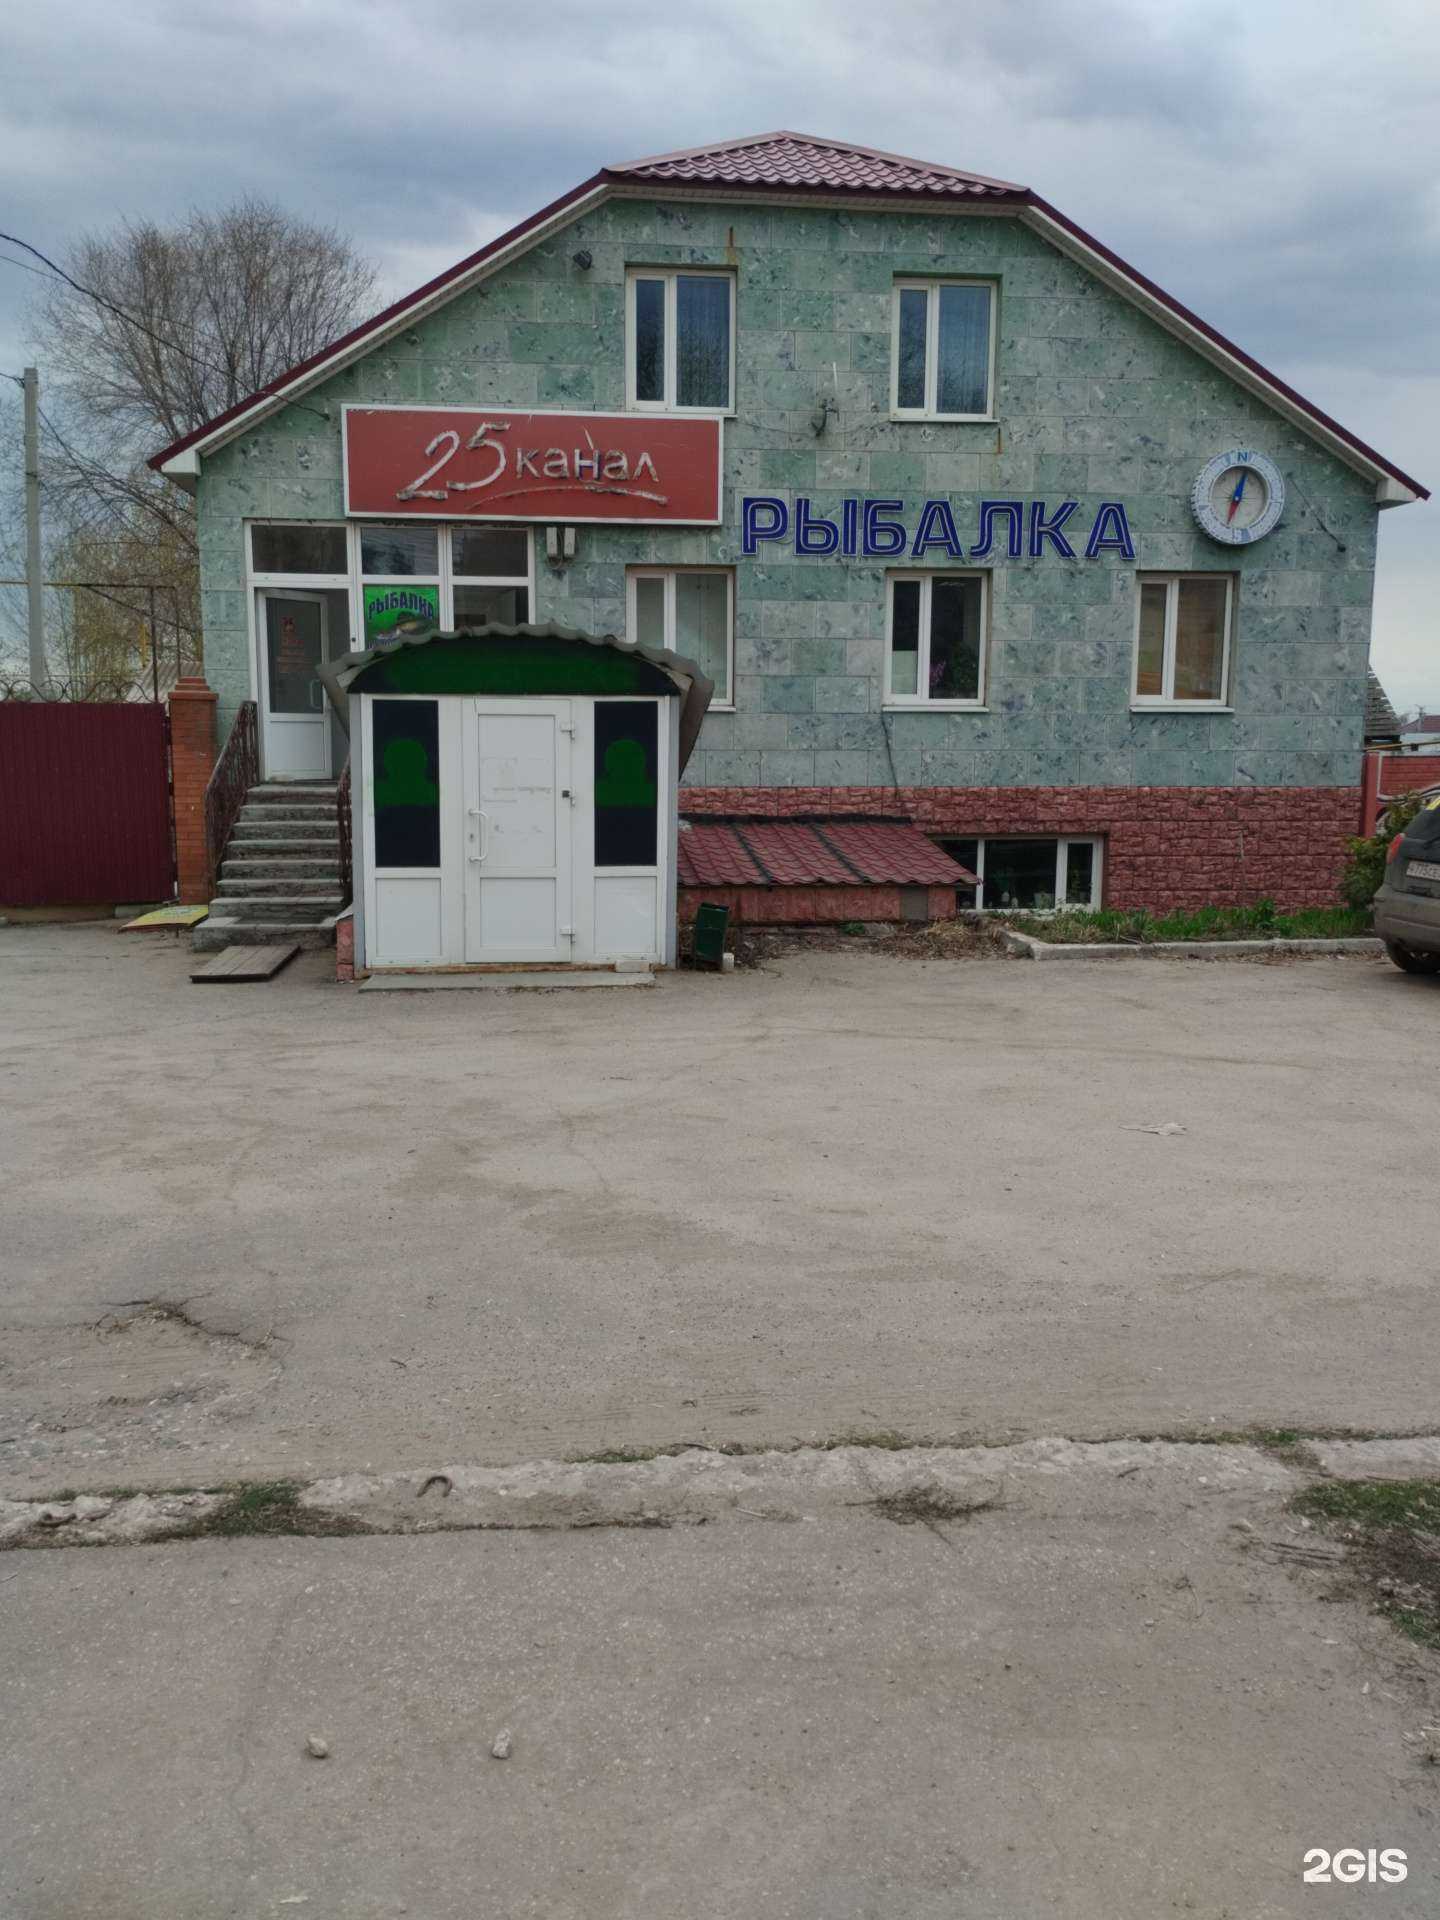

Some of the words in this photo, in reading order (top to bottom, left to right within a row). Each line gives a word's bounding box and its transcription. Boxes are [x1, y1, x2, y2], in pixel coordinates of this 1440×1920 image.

[396, 421, 511, 502] 25
[516, 447, 658, 482] канал
[1237, 451, 1248, 462] N
[743, 498, 1136, 559] РЫБАЛКА
